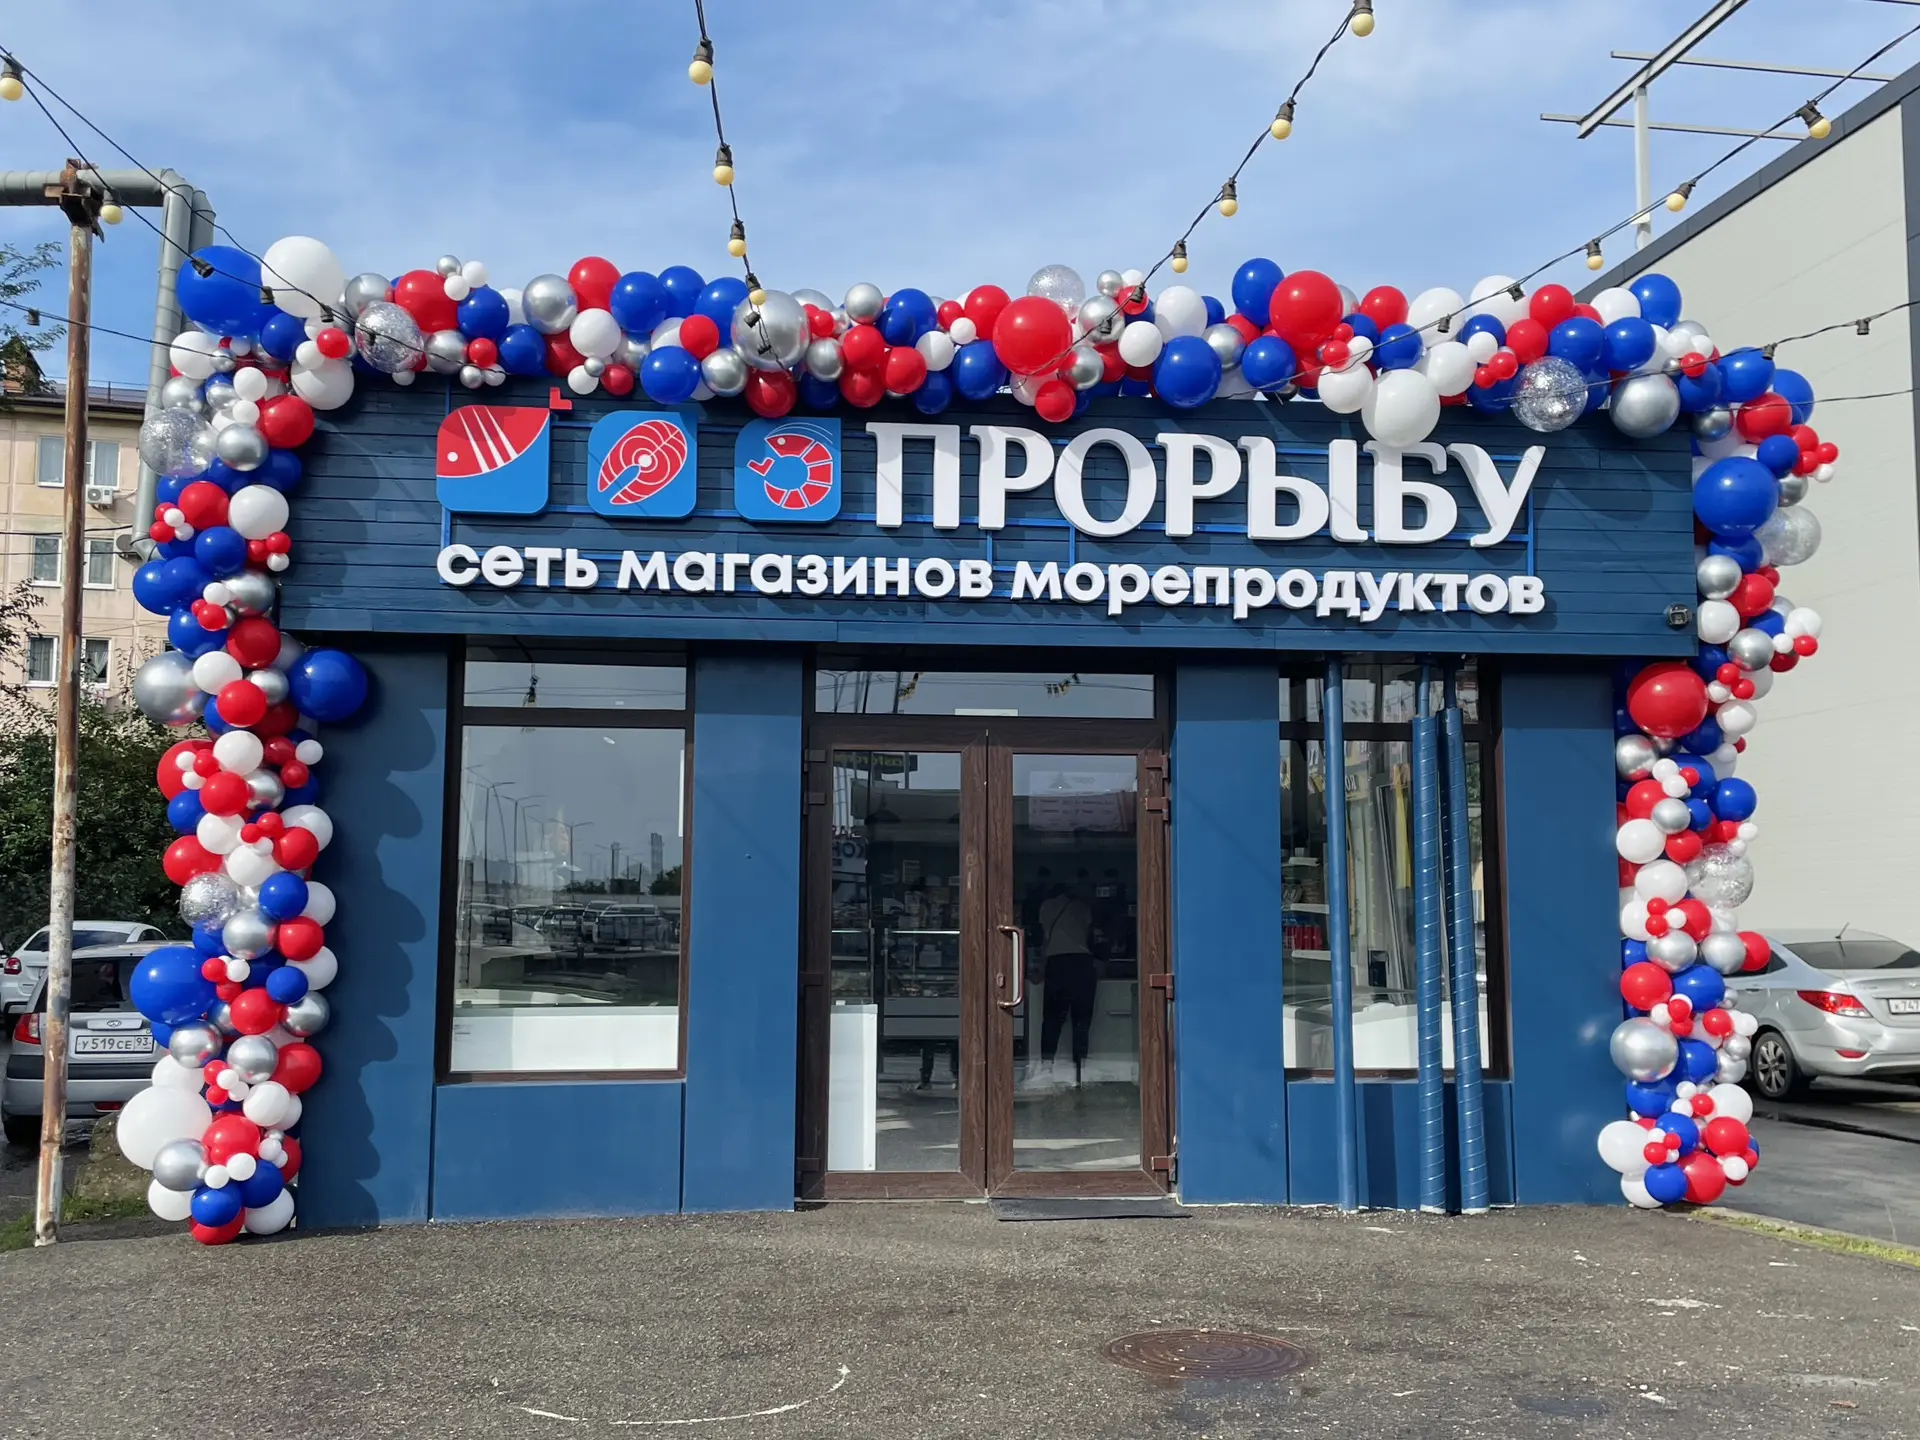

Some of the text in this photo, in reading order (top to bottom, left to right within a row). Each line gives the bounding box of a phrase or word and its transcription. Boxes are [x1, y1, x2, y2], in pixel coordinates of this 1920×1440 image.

[865, 420, 1547, 548] ПРОРЫБУ
[436, 543, 1546, 623] сеть магазинов морепродуктов
